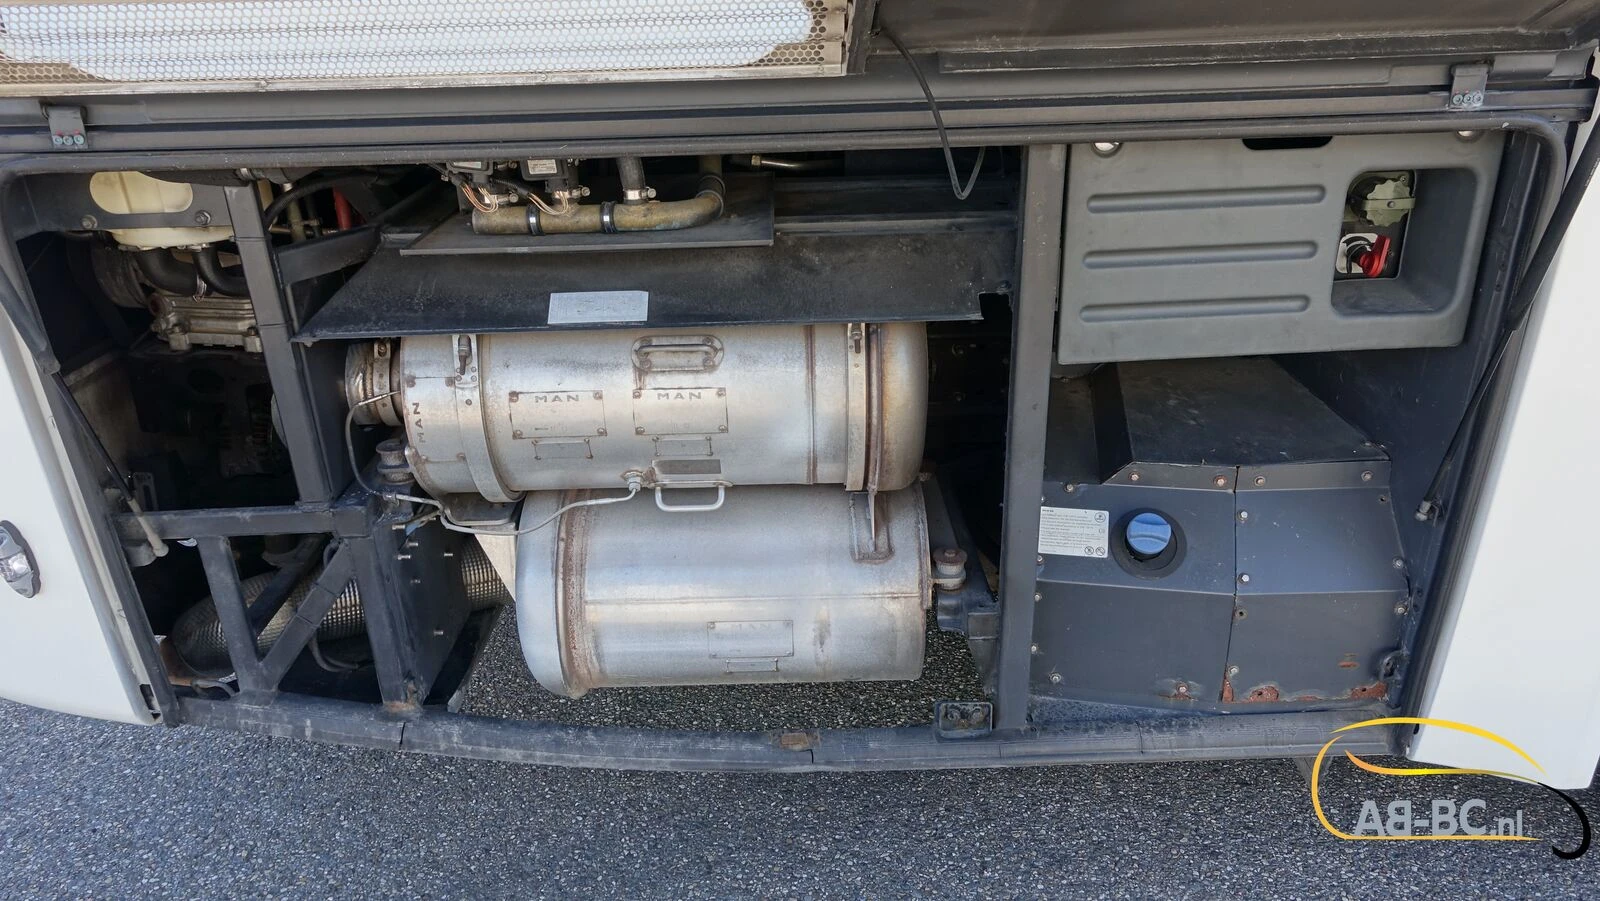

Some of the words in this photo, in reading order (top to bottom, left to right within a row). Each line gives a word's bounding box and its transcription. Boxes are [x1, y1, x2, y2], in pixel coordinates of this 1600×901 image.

[535, 394, 579, 403] MAN
[657, 392, 702, 400] MAN
[412, 402, 426, 443] MAN
